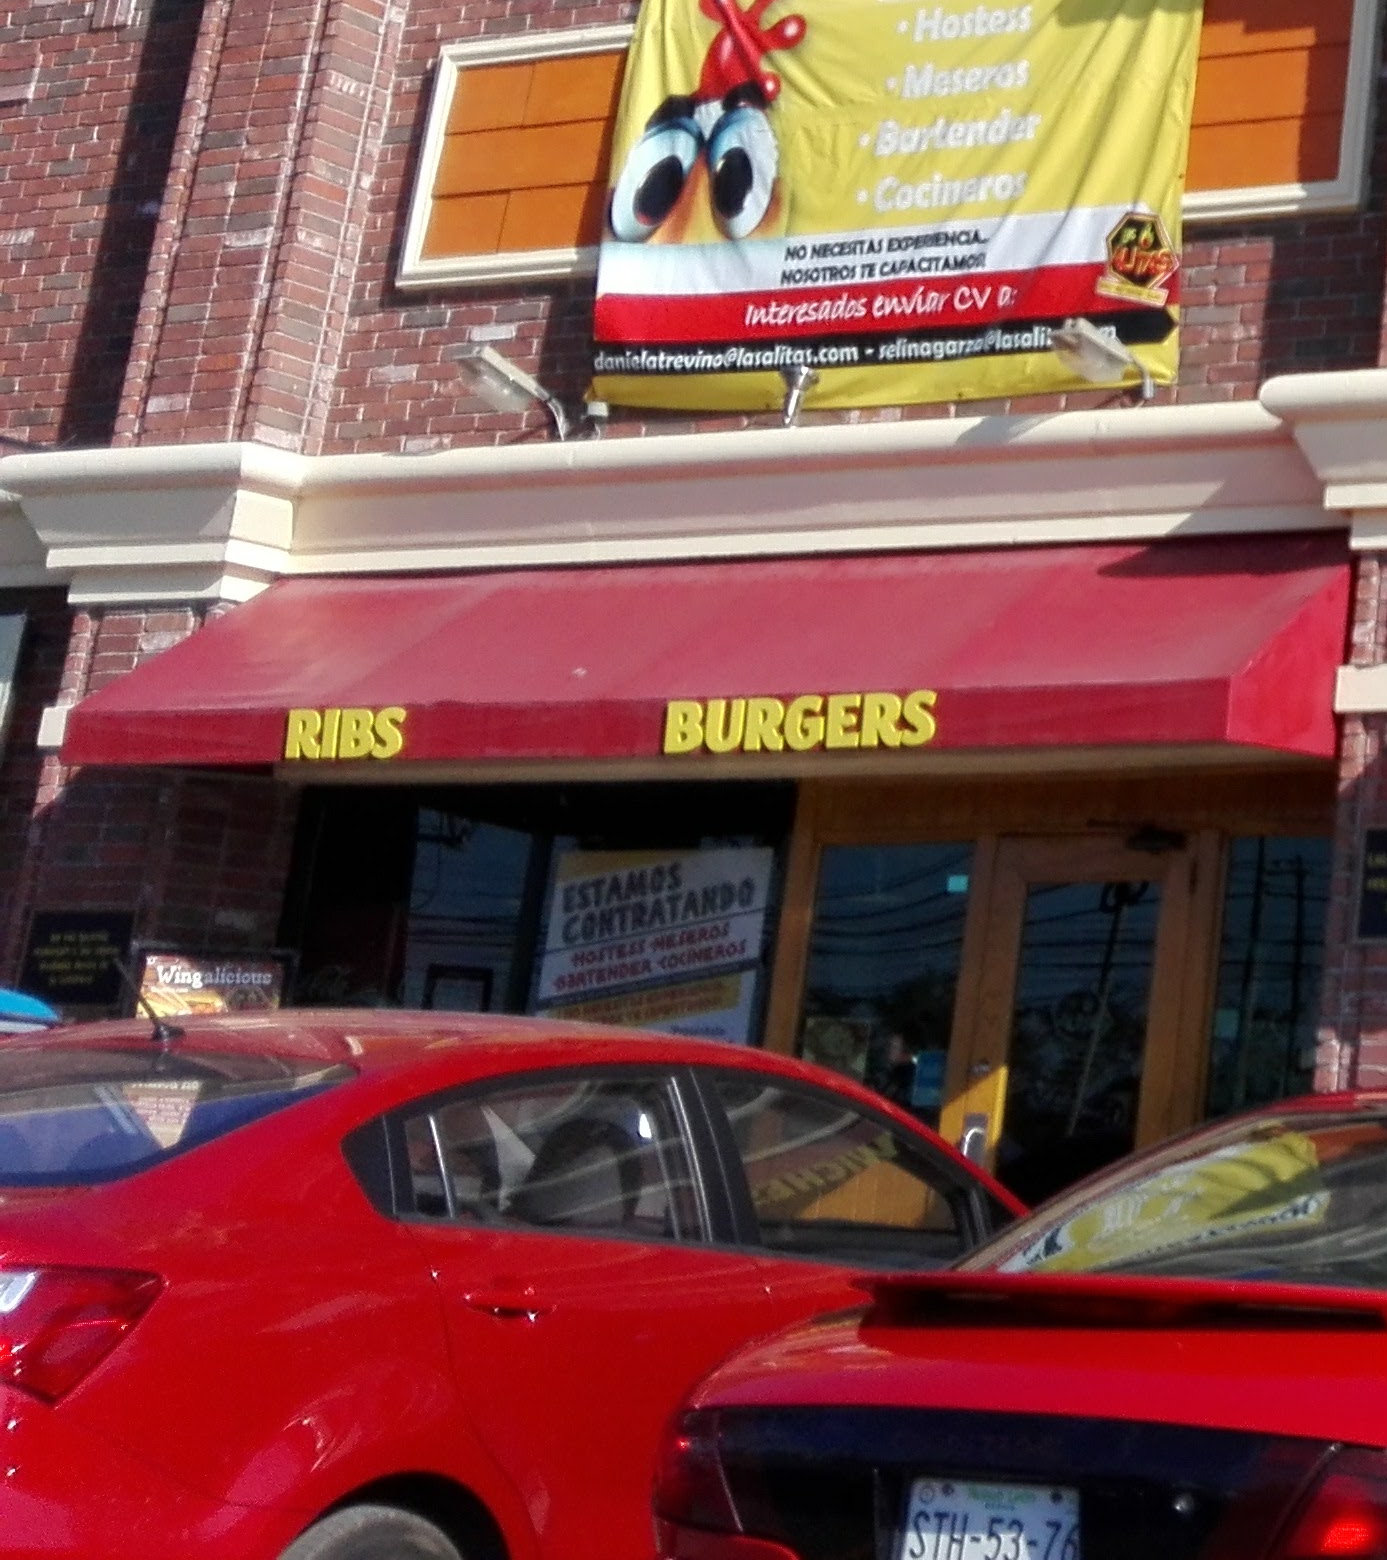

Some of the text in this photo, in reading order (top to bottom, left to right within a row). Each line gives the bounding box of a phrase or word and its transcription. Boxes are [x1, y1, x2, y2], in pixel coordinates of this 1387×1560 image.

[780, 264, 857, 286] NOSOTROS
[861, 262, 878, 280] TE
[785, 245, 808, 262] NO
[744, 293, 868, 327] Interesados
[954, 283, 993, 312] CV
[284, 690, 938, 760] RIBS BURGERS
[562, 862, 683, 914] ESTAMOS
[562, 877, 756, 944] CONTRATANDO
[156, 965, 272, 989] Wingalicious
